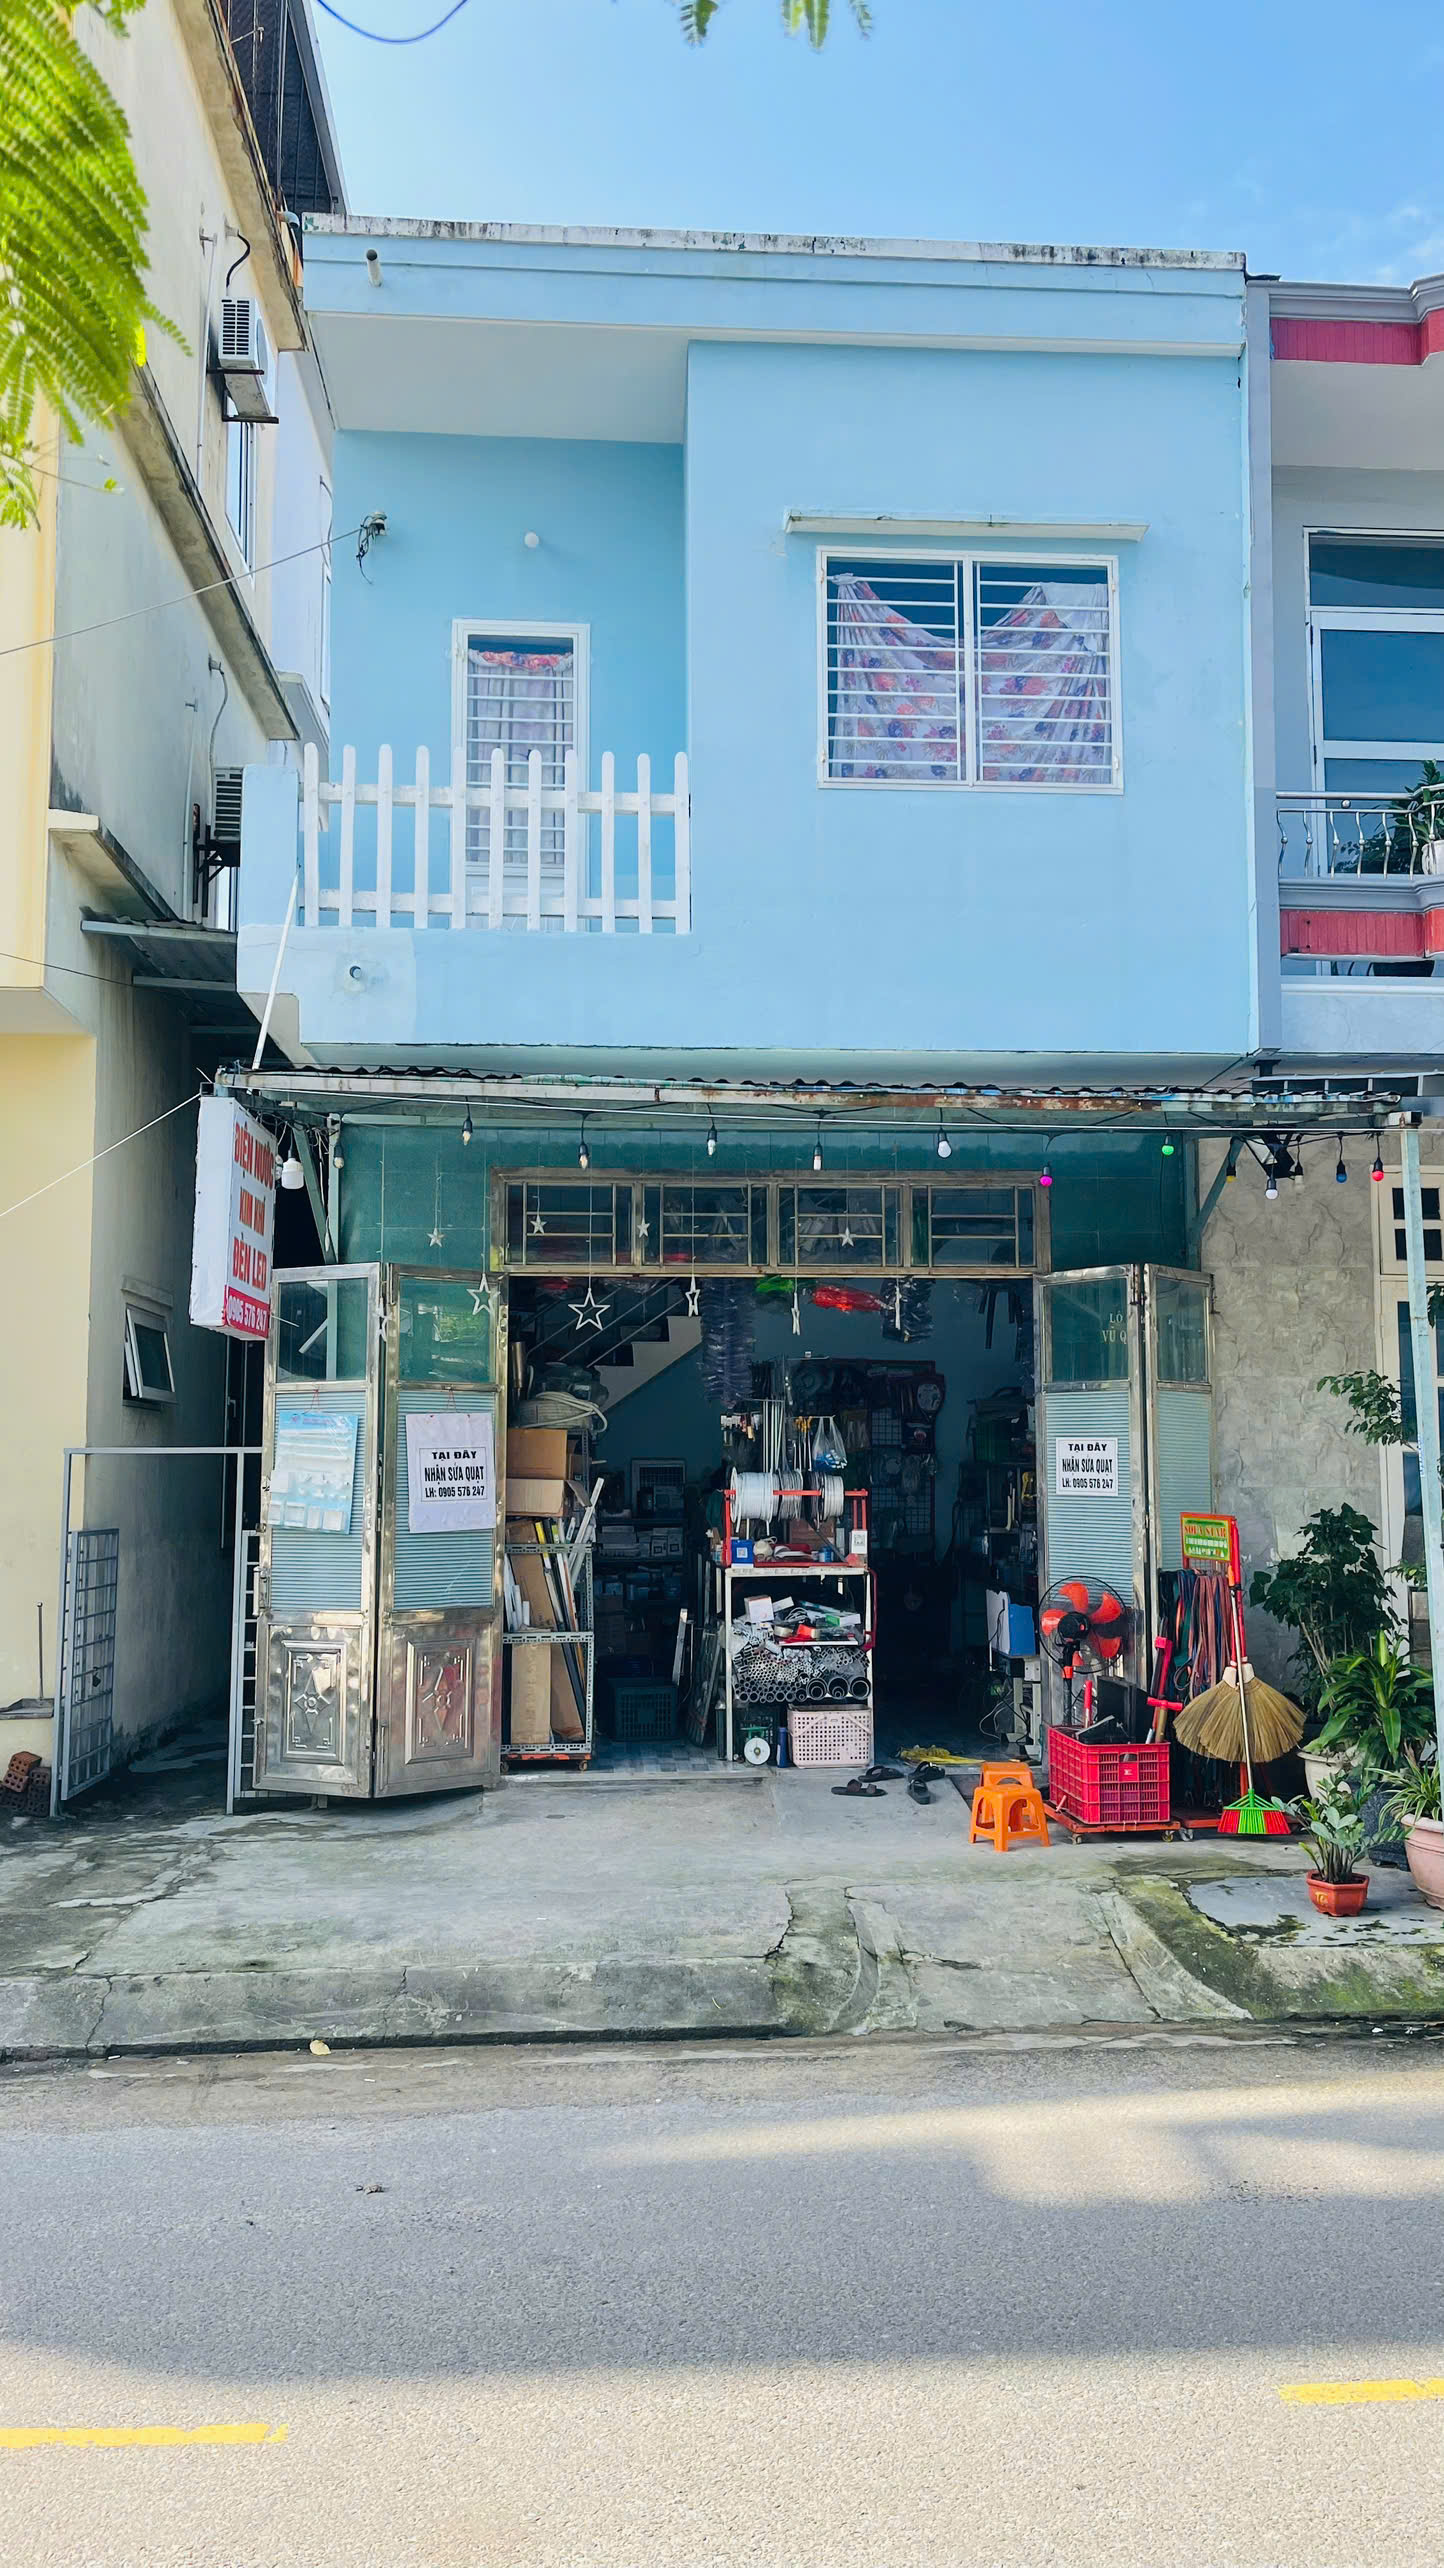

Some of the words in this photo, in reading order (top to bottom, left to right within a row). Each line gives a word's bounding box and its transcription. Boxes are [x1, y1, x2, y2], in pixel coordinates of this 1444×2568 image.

[234, 1121, 253, 1178] ĐIỆN
[239, 1187, 253, 1229] KIM
[233, 1232, 251, 1284] ĐÈN
[252, 1248, 267, 1291] LED
[244, 1302, 256, 1328] 576
[256, 1307, 267, 1332] 247
[431, 1451, 450, 1461] TẠI
[453, 1449, 477, 1459] ĐÂY
[1068, 1443, 1084, 1453] TẠI
[1087, 1442, 1107, 1451] ĐÂY
[424, 1464, 446, 1485] NHẬN
[465, 1466, 484, 1484] QUẠT
[1062, 1456, 1080, 1475] NHẬN
[1096, 1458, 1113, 1476] QUẠT
[425, 1487, 437, 1498] LH:
[438, 1486, 456, 1497] 0905
[457, 1486, 471, 1497] 576
[472, 1485, 485, 1496] 247
[1062, 1477, 1071, 1488] LH:
[1072, 1477, 1088, 1488] 0905
[1089, 1478, 1101, 1488] 576
[1101, 1478, 1113, 1489] 247
